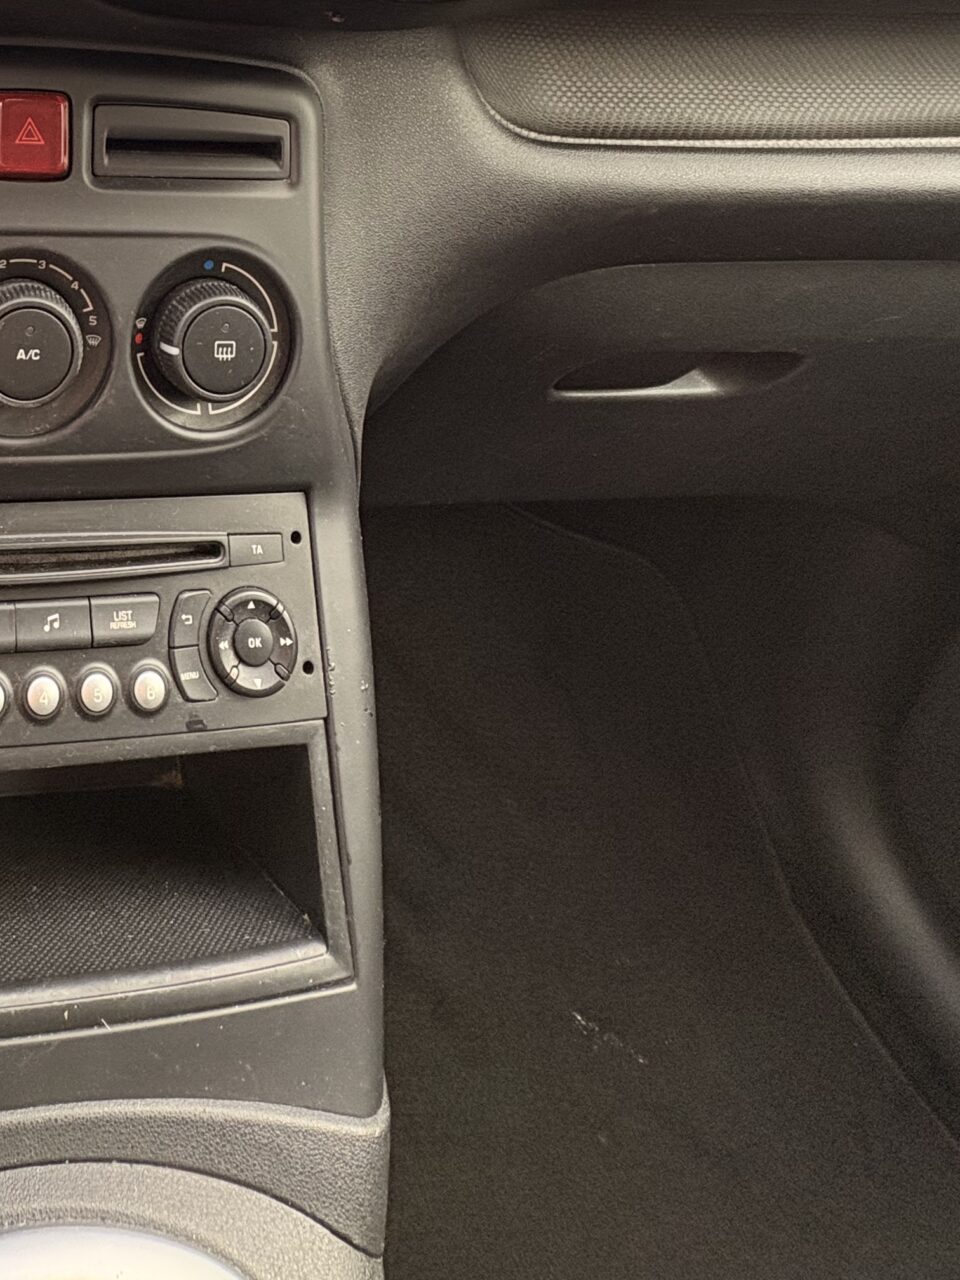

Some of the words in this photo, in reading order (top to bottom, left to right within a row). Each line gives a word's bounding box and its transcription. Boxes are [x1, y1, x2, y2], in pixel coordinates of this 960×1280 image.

[38, 259, 47, 269] 3
[70, 281, 79, 291] 4
[89, 315, 98, 326] 5
[16, 348, 41, 361] A/C
[251, 544, 264, 555] TA
[113, 610, 134, 621] LIST
[110, 620, 137, 630] REFRESH
[248, 640, 263, 649] OK
[180, 671, 200, 681] MENU
[93, 686, 103, 703] 5
[146, 684, 156, 700] 6
[39, 690, 49, 706] 4
